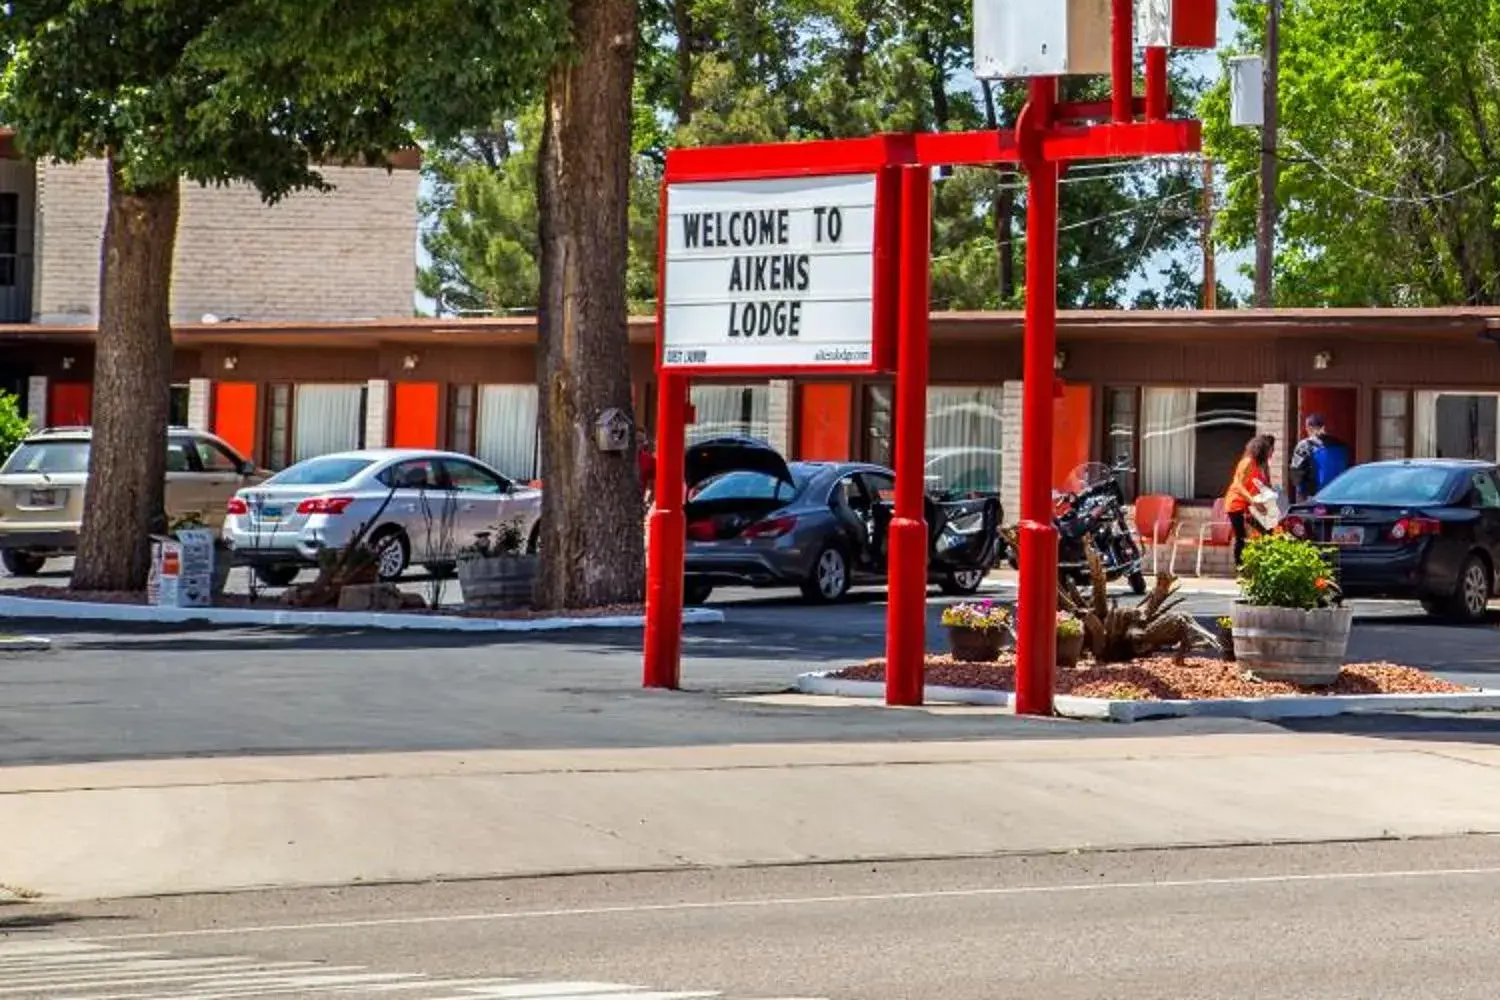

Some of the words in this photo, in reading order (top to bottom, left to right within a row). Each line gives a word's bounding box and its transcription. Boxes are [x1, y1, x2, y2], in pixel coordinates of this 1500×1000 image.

[683, 209, 790, 249] WELCOME
[813, 206, 842, 243] TO
[728, 254, 810, 292] AIKENS
[727, 300, 801, 337] LODGE
